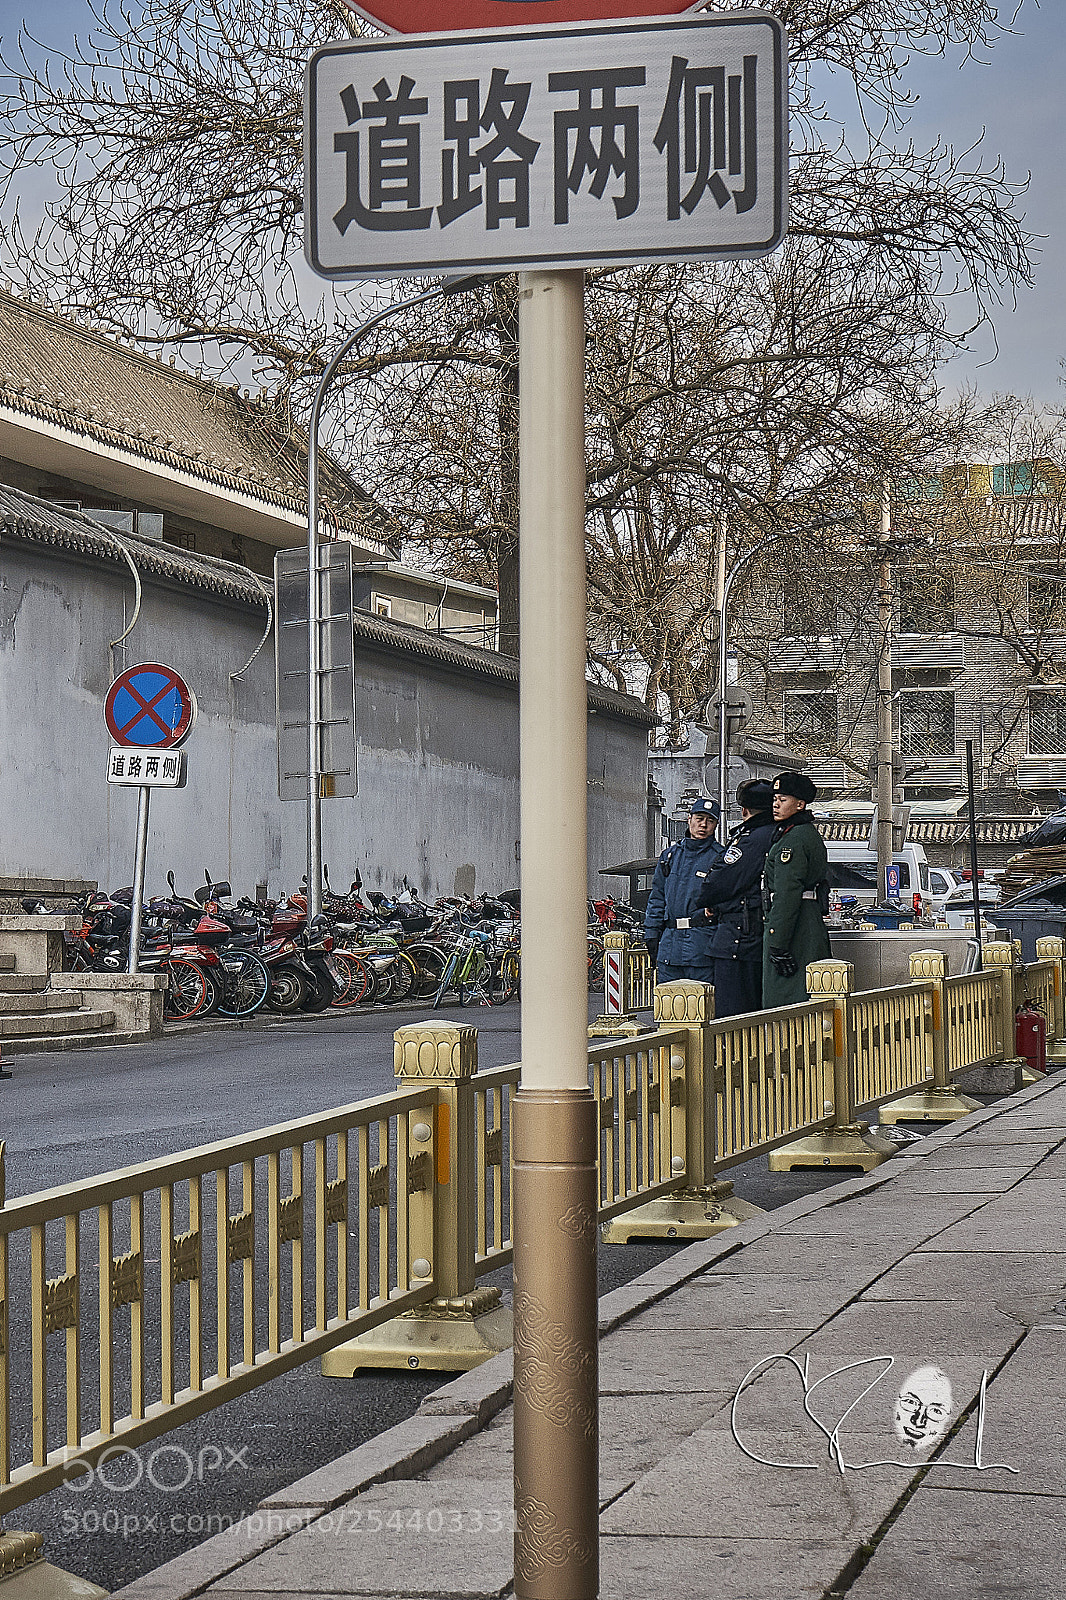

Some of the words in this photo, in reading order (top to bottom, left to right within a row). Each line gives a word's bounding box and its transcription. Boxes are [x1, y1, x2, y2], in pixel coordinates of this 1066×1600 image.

[332, 54, 758, 237] 道路两侧
[111, 754, 177, 779] 道路两侧
